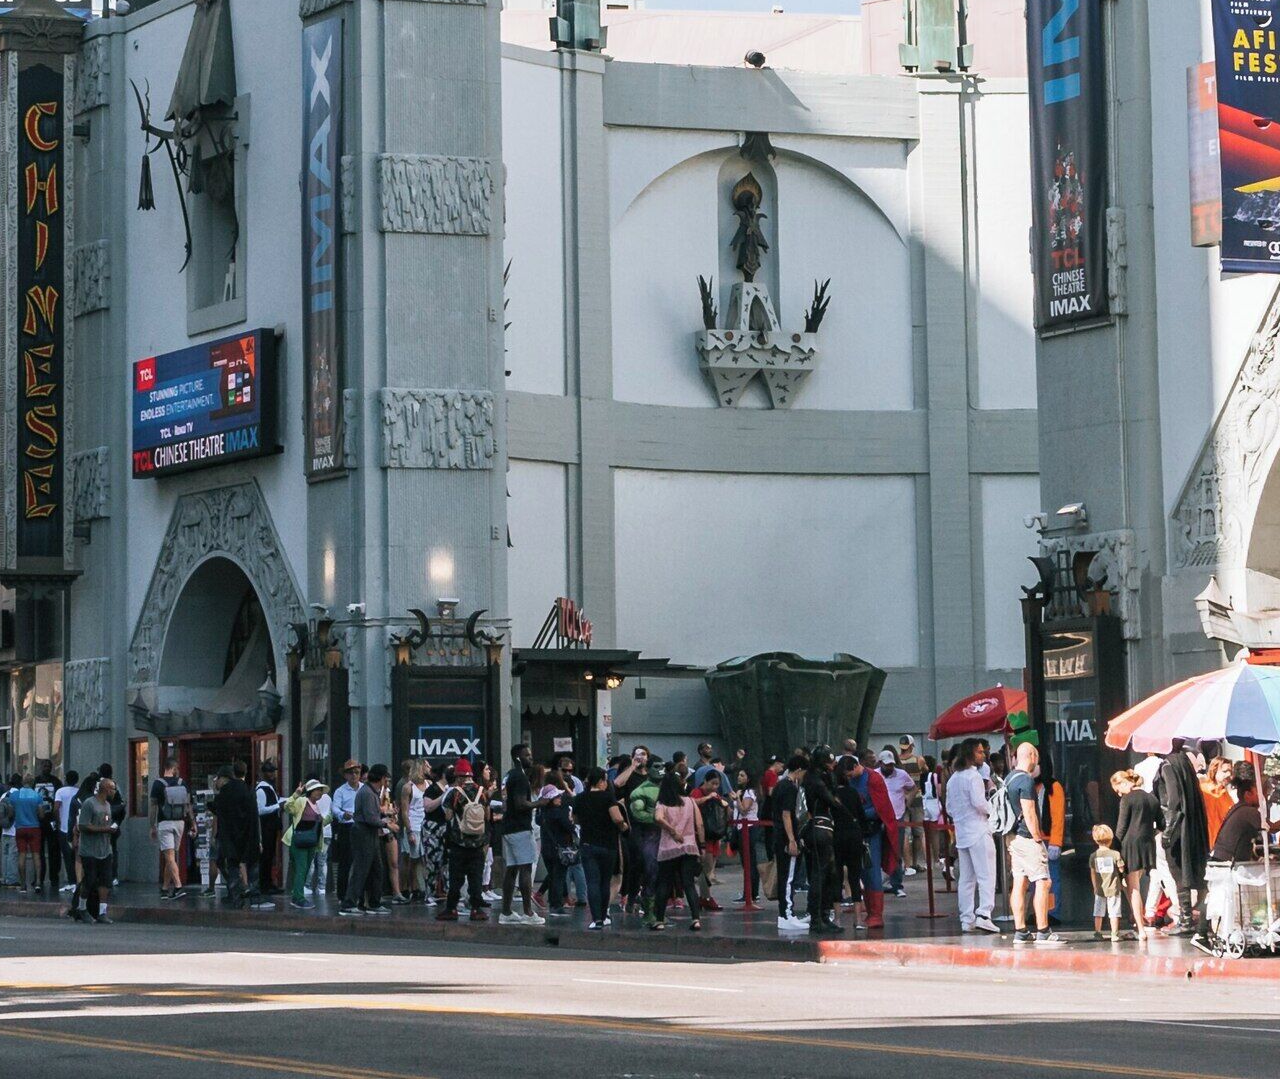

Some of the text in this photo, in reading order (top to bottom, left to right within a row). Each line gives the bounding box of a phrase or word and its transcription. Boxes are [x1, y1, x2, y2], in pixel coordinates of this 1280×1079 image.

[1233, 28, 1276, 51] AFI
[309, 34, 334, 313] IMAX
[1051, 248, 1087, 269] TCL
[1052, 268, 1085, 285] CHINESE
[1053, 280, 1086, 297] THEATRE
[22, 101, 60, 519] CHINESE
[1050, 294, 1092, 317] IMAX
[140, 369, 154, 382] TCL
[149, 386, 179, 403] STUNNING
[140, 405, 166, 422] ENDLESS
[133, 425, 259, 473] TCL CHINESE THEATRE IMAX
[313, 456, 335, 471] IMAX
[1054, 719, 1098, 742] IMA
[308, 743, 329, 760] IMA
[410, 738, 482, 756] IMAX
